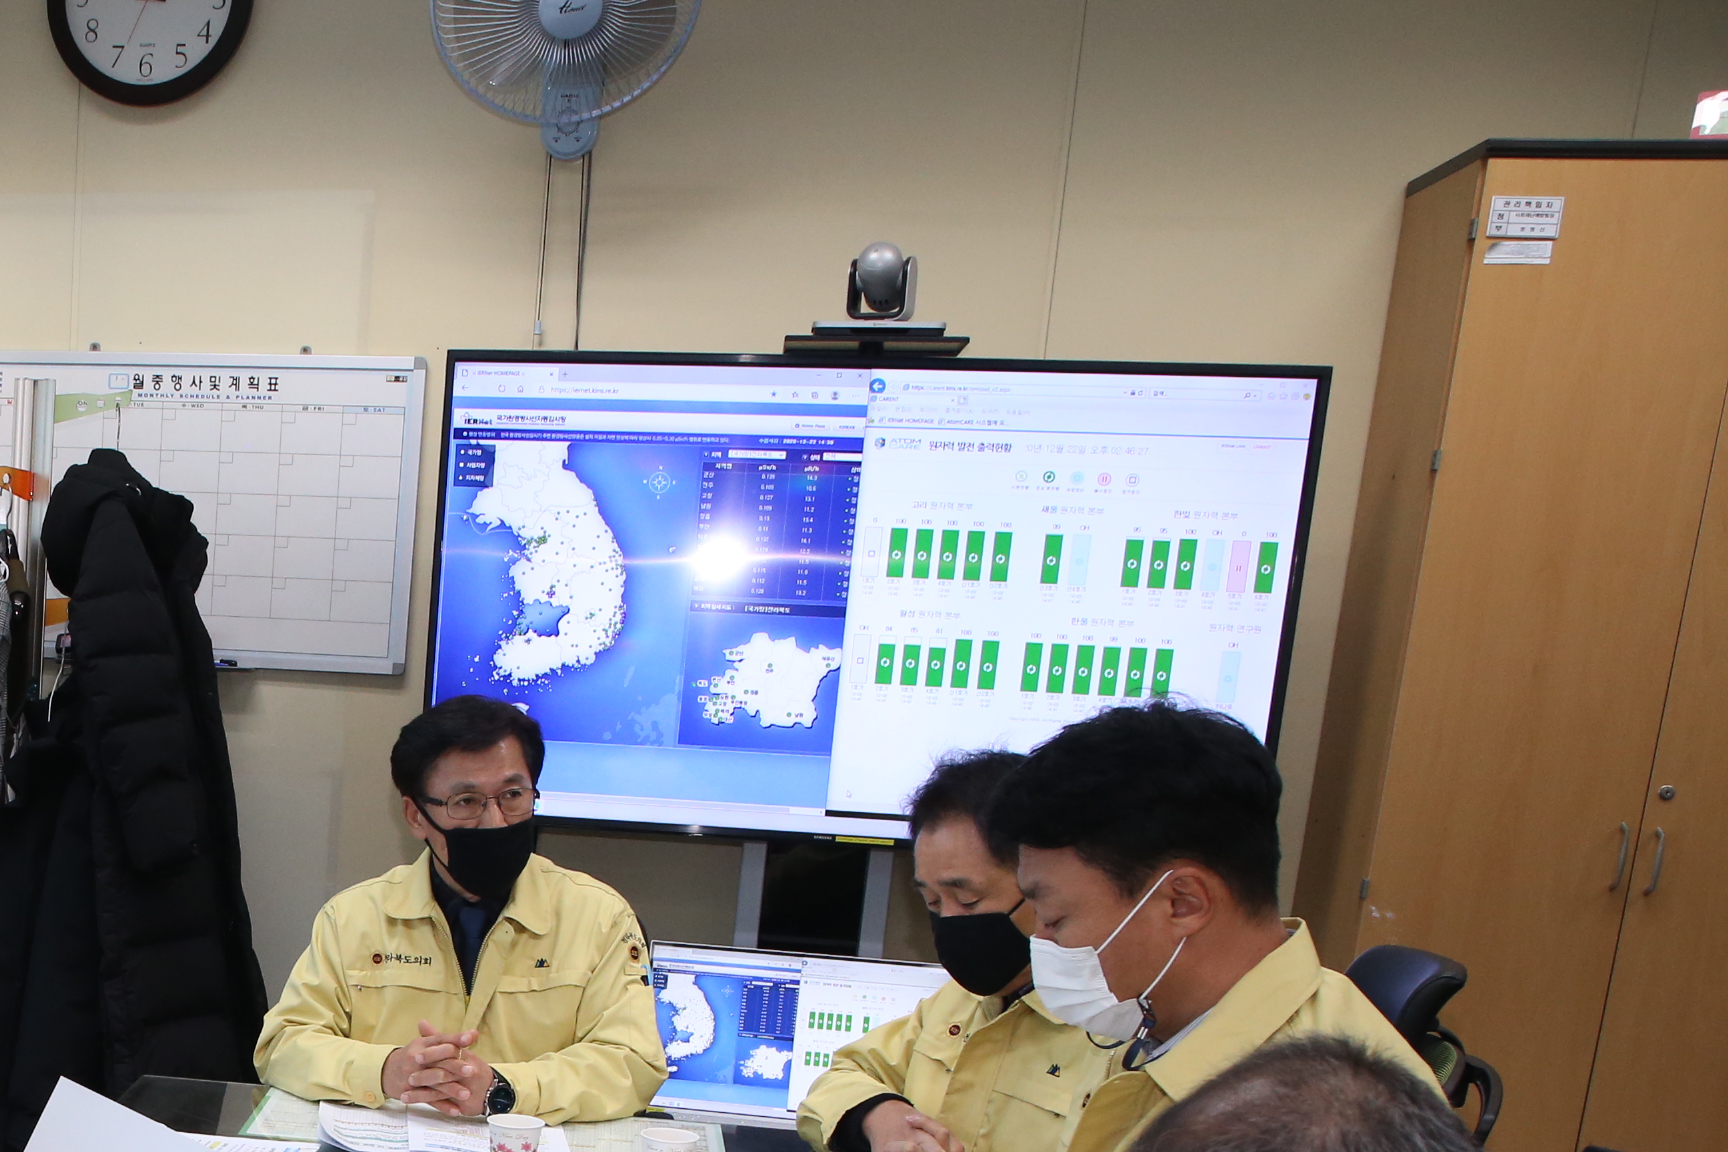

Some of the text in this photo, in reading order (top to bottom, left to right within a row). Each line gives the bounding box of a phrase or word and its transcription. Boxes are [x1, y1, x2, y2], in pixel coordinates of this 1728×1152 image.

[85, 18, 99, 43] 8
[197, 19, 212, 44] 4
[111, 45, 125, 68] 7
[139, 53, 154, 78] 6
[175, 44, 188, 69] 5
[929, 440, 955, 451] 원자력
[957, 441, 975, 452] 발전
